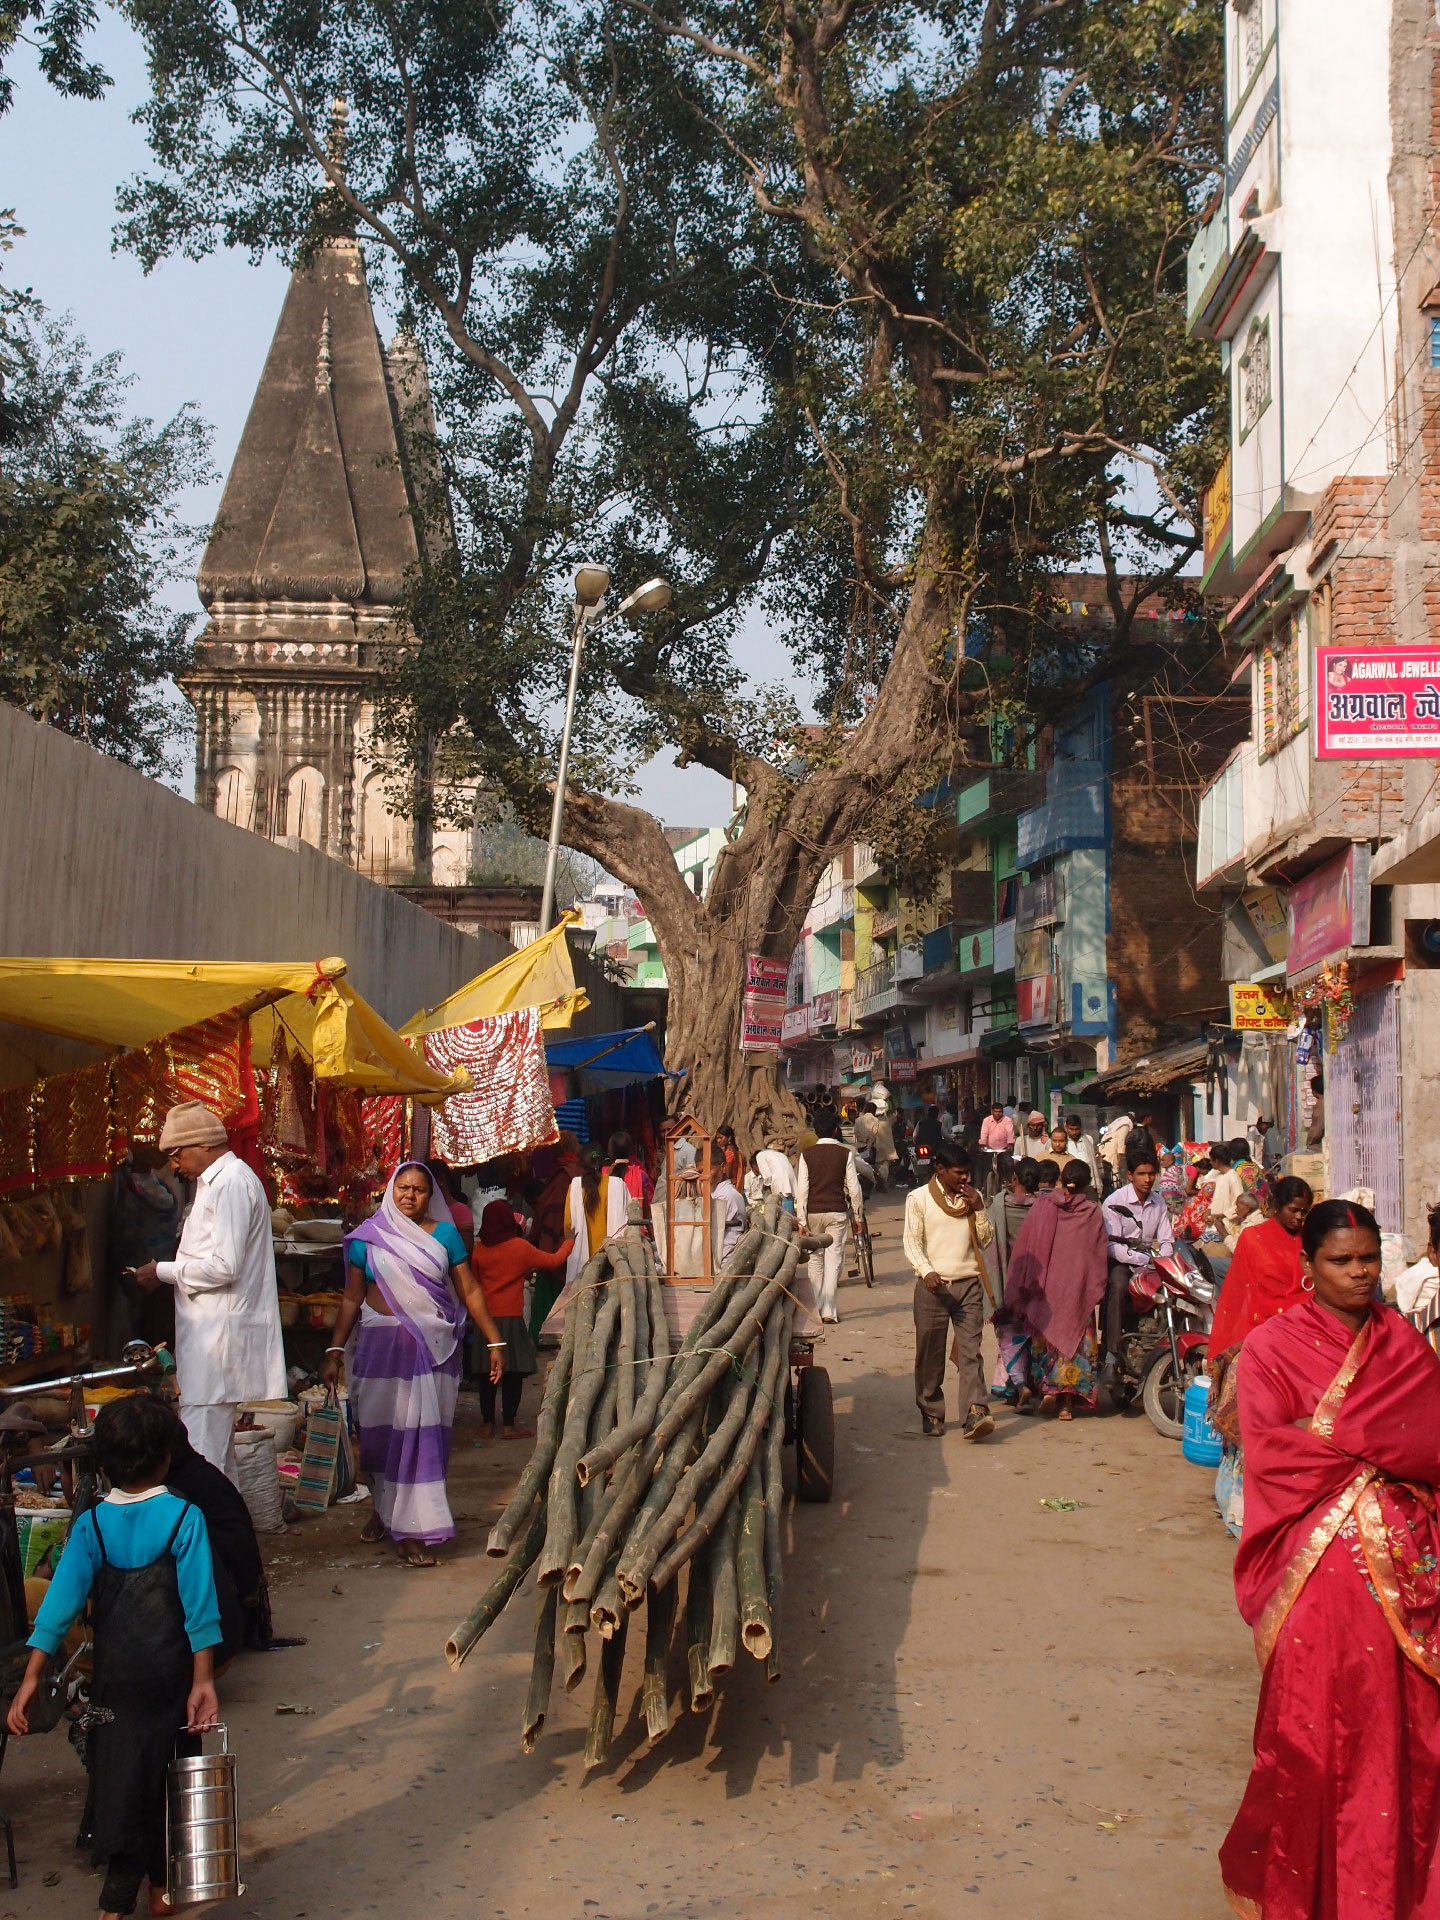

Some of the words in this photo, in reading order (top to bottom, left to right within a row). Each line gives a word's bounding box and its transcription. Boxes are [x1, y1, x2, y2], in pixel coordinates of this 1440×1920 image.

[1352, 662, 1398, 679] AGARWAL
[1330, 694, 1406, 721] अग्रवाल
[1235, 990, 1260, 1000] उत्तम
[1236, 1015, 1262, 1027] गिफ्ट
